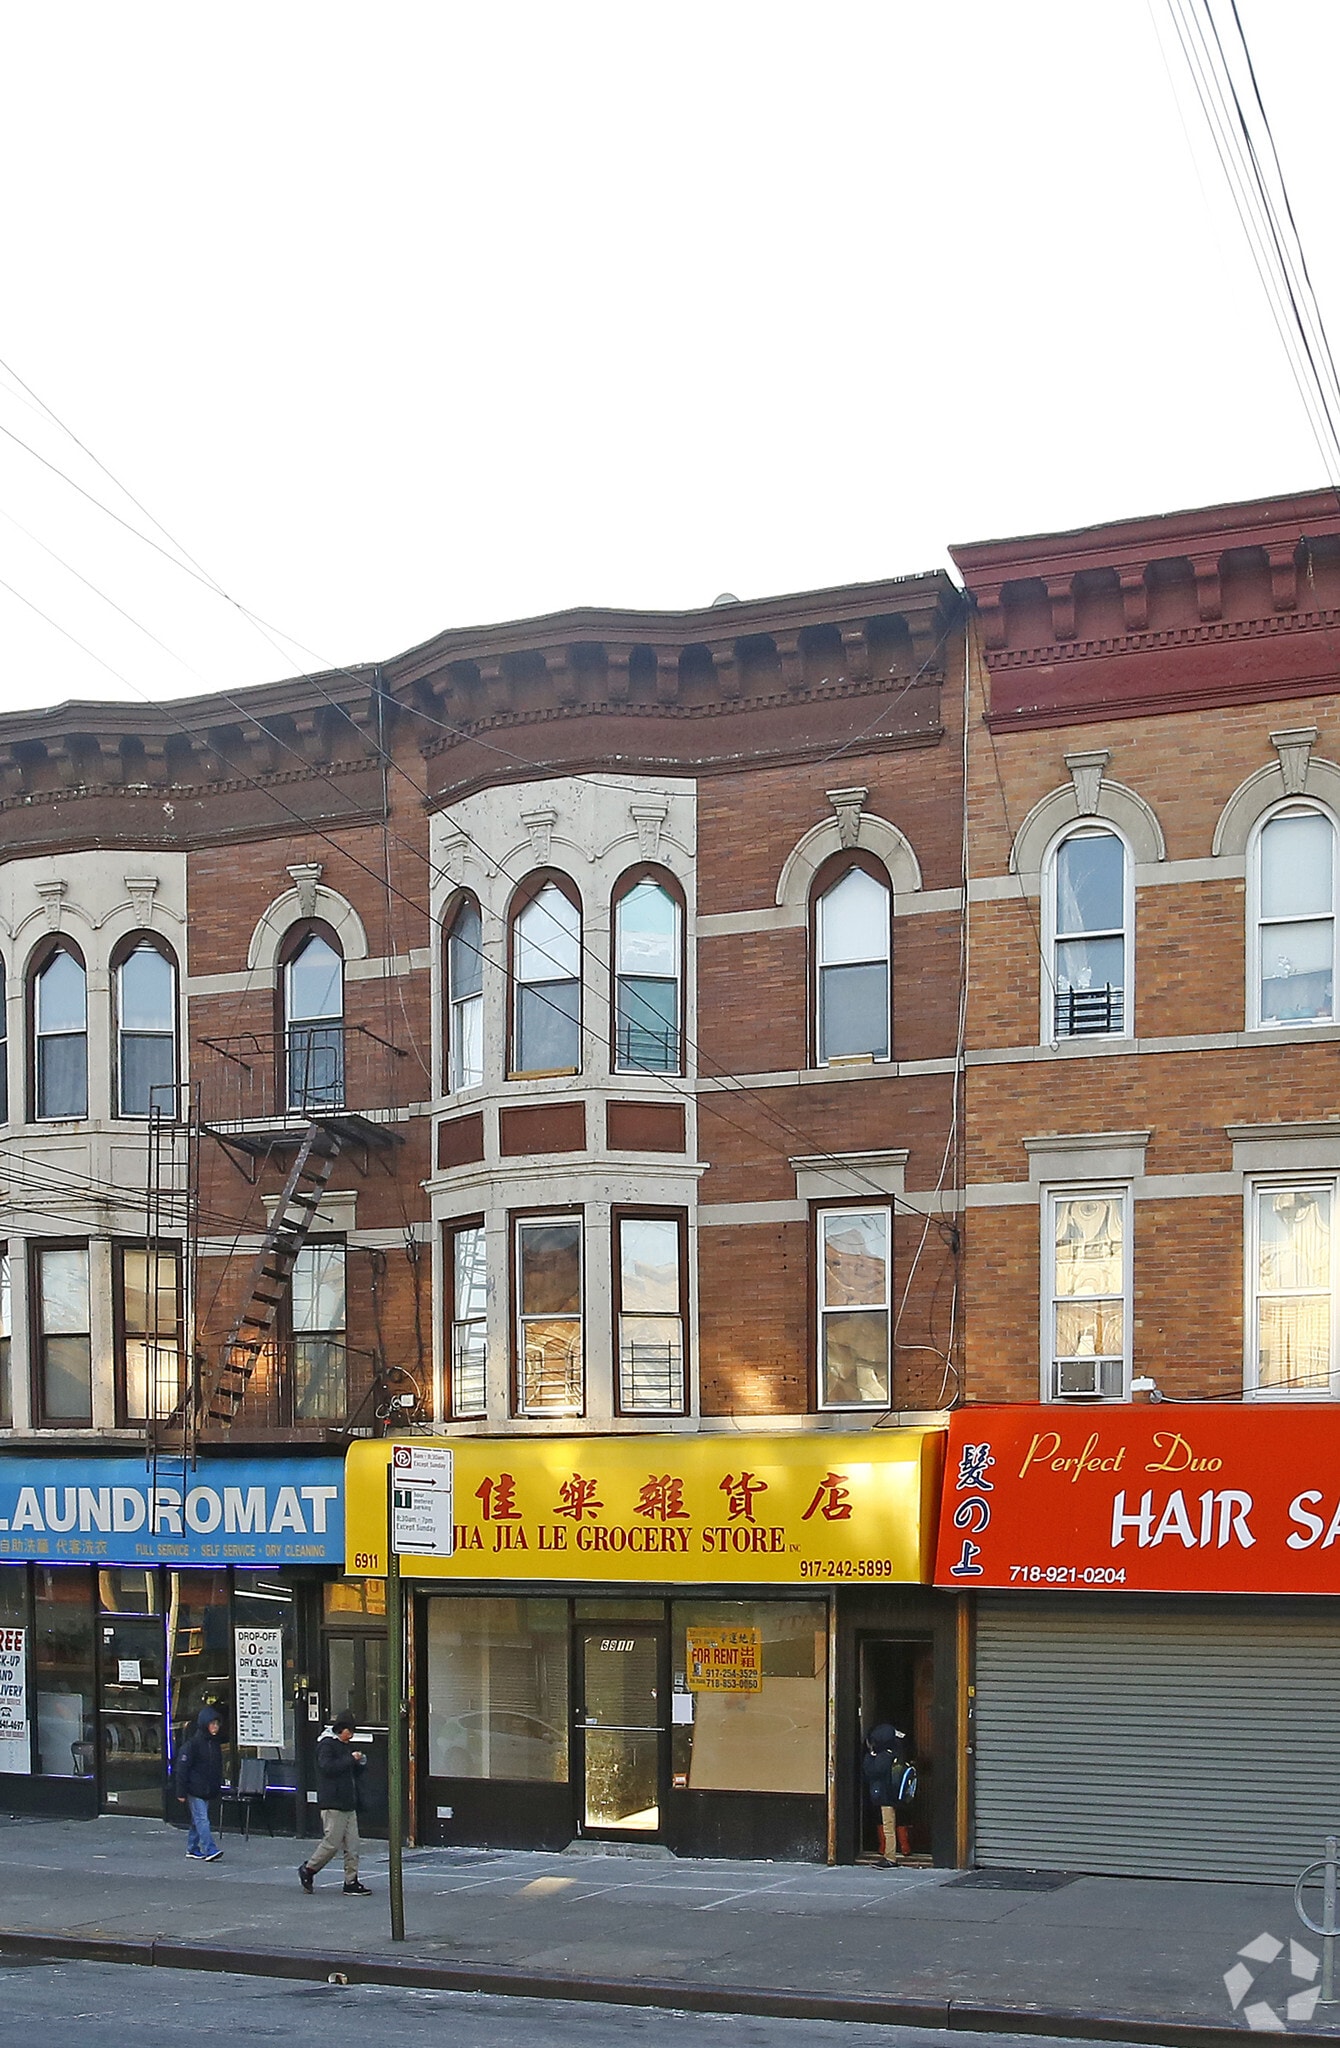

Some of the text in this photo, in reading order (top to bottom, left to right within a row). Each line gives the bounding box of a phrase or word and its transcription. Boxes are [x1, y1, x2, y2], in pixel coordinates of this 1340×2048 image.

[1019, 1431, 1223, 1483] Perfect Duo
[430, 1461, 446, 1470] Sunday
[0, 1485, 338, 1534] AUNDROMAT
[1110, 1489, 1257, 1549] HAIR
[396, 1522, 436, 1533] Except Sunday
[453, 1525, 484, 1551] JIA
[493, 1525, 529, 1552] JIA
[537, 1525, 567, 1551] LE
[576, 1526, 693, 1553] GROCERY
[702, 1527, 785, 1553] STORE
[136, 1544, 326, 1557] FULL SERVICE SELF SERVICE DRY CLEANING
[355, 1553, 378, 1569] 6911
[800, 1560, 892, 1577] 917-242-5899
[1009, 1565, 1126, 1583] 718-921-0204
[238, 1631, 277, 1641] DROP-OFF
[601, 1640, 635, 1651] 6911
[0, 1654, 20, 1667] K-UP
[240, 1657, 278, 1668] DRY CLEAN
[692, 1648, 739, 1665] FOR RENT
[741, 1646, 755, 1668] 出租
[0, 1684, 23, 1697] IVERY
